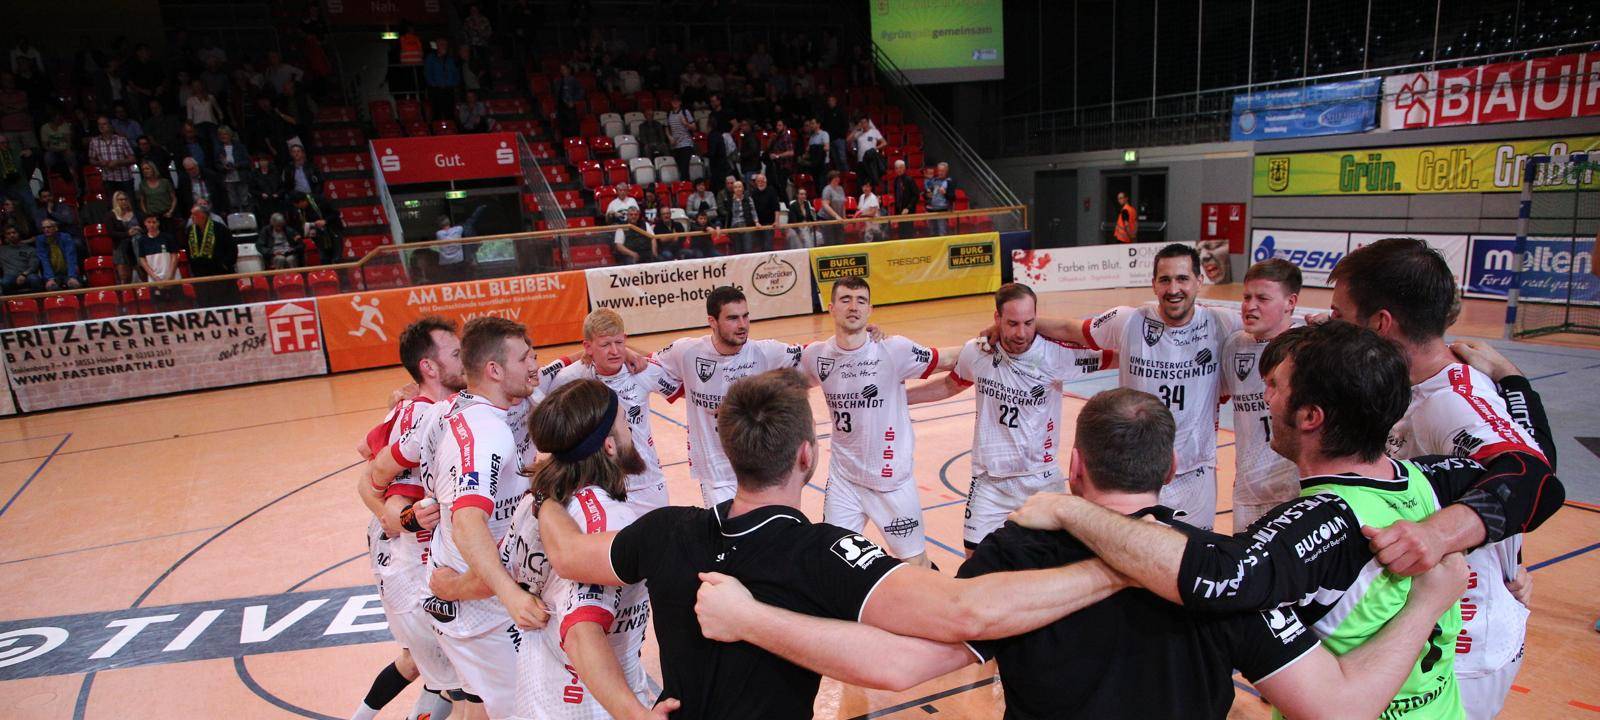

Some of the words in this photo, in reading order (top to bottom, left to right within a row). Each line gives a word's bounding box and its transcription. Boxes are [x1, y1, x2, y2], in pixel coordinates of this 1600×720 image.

[435, 153, 465, 168] Gut.
[1339, 153, 1401, 192] Grün.
[1416, 148, 1479, 190] Gelb.
[887, 255, 932, 267] TRESORE
[960, 246, 984, 255] BURG
[829, 258, 856, 267] BURG
[1058, 261, 1085, 272] Farbe
[1088, 261, 1099, 271] im
[1102, 259, 1122, 270] Blut.
[610, 267, 699, 288] Zweibrücker
[703, 264, 727, 281] Hof
[755, 270, 794, 281] Zweibrücker
[770, 277, 780, 285] Hof
[407, 288, 437, 305] AM
[441, 283, 486, 302] BALL
[489, 275, 566, 297] BLEIBEN.
[1, 324, 80, 350] FRITZ
[86, 306, 252, 341] FASTENRATH
[6, 326, 256, 364] BAUUNTERNEHMUNG
[218, 344, 239, 362] seit
[241, 333, 267, 356] 1934
[13, 359, 175, 386] WWW.FASTENRATH.EU
[1130, 356, 1193, 369] UMWELTSERVICE
[1159, 385, 1185, 410] 34
[834, 411, 852, 433] 23
[1000, 405, 1019, 428] 22
